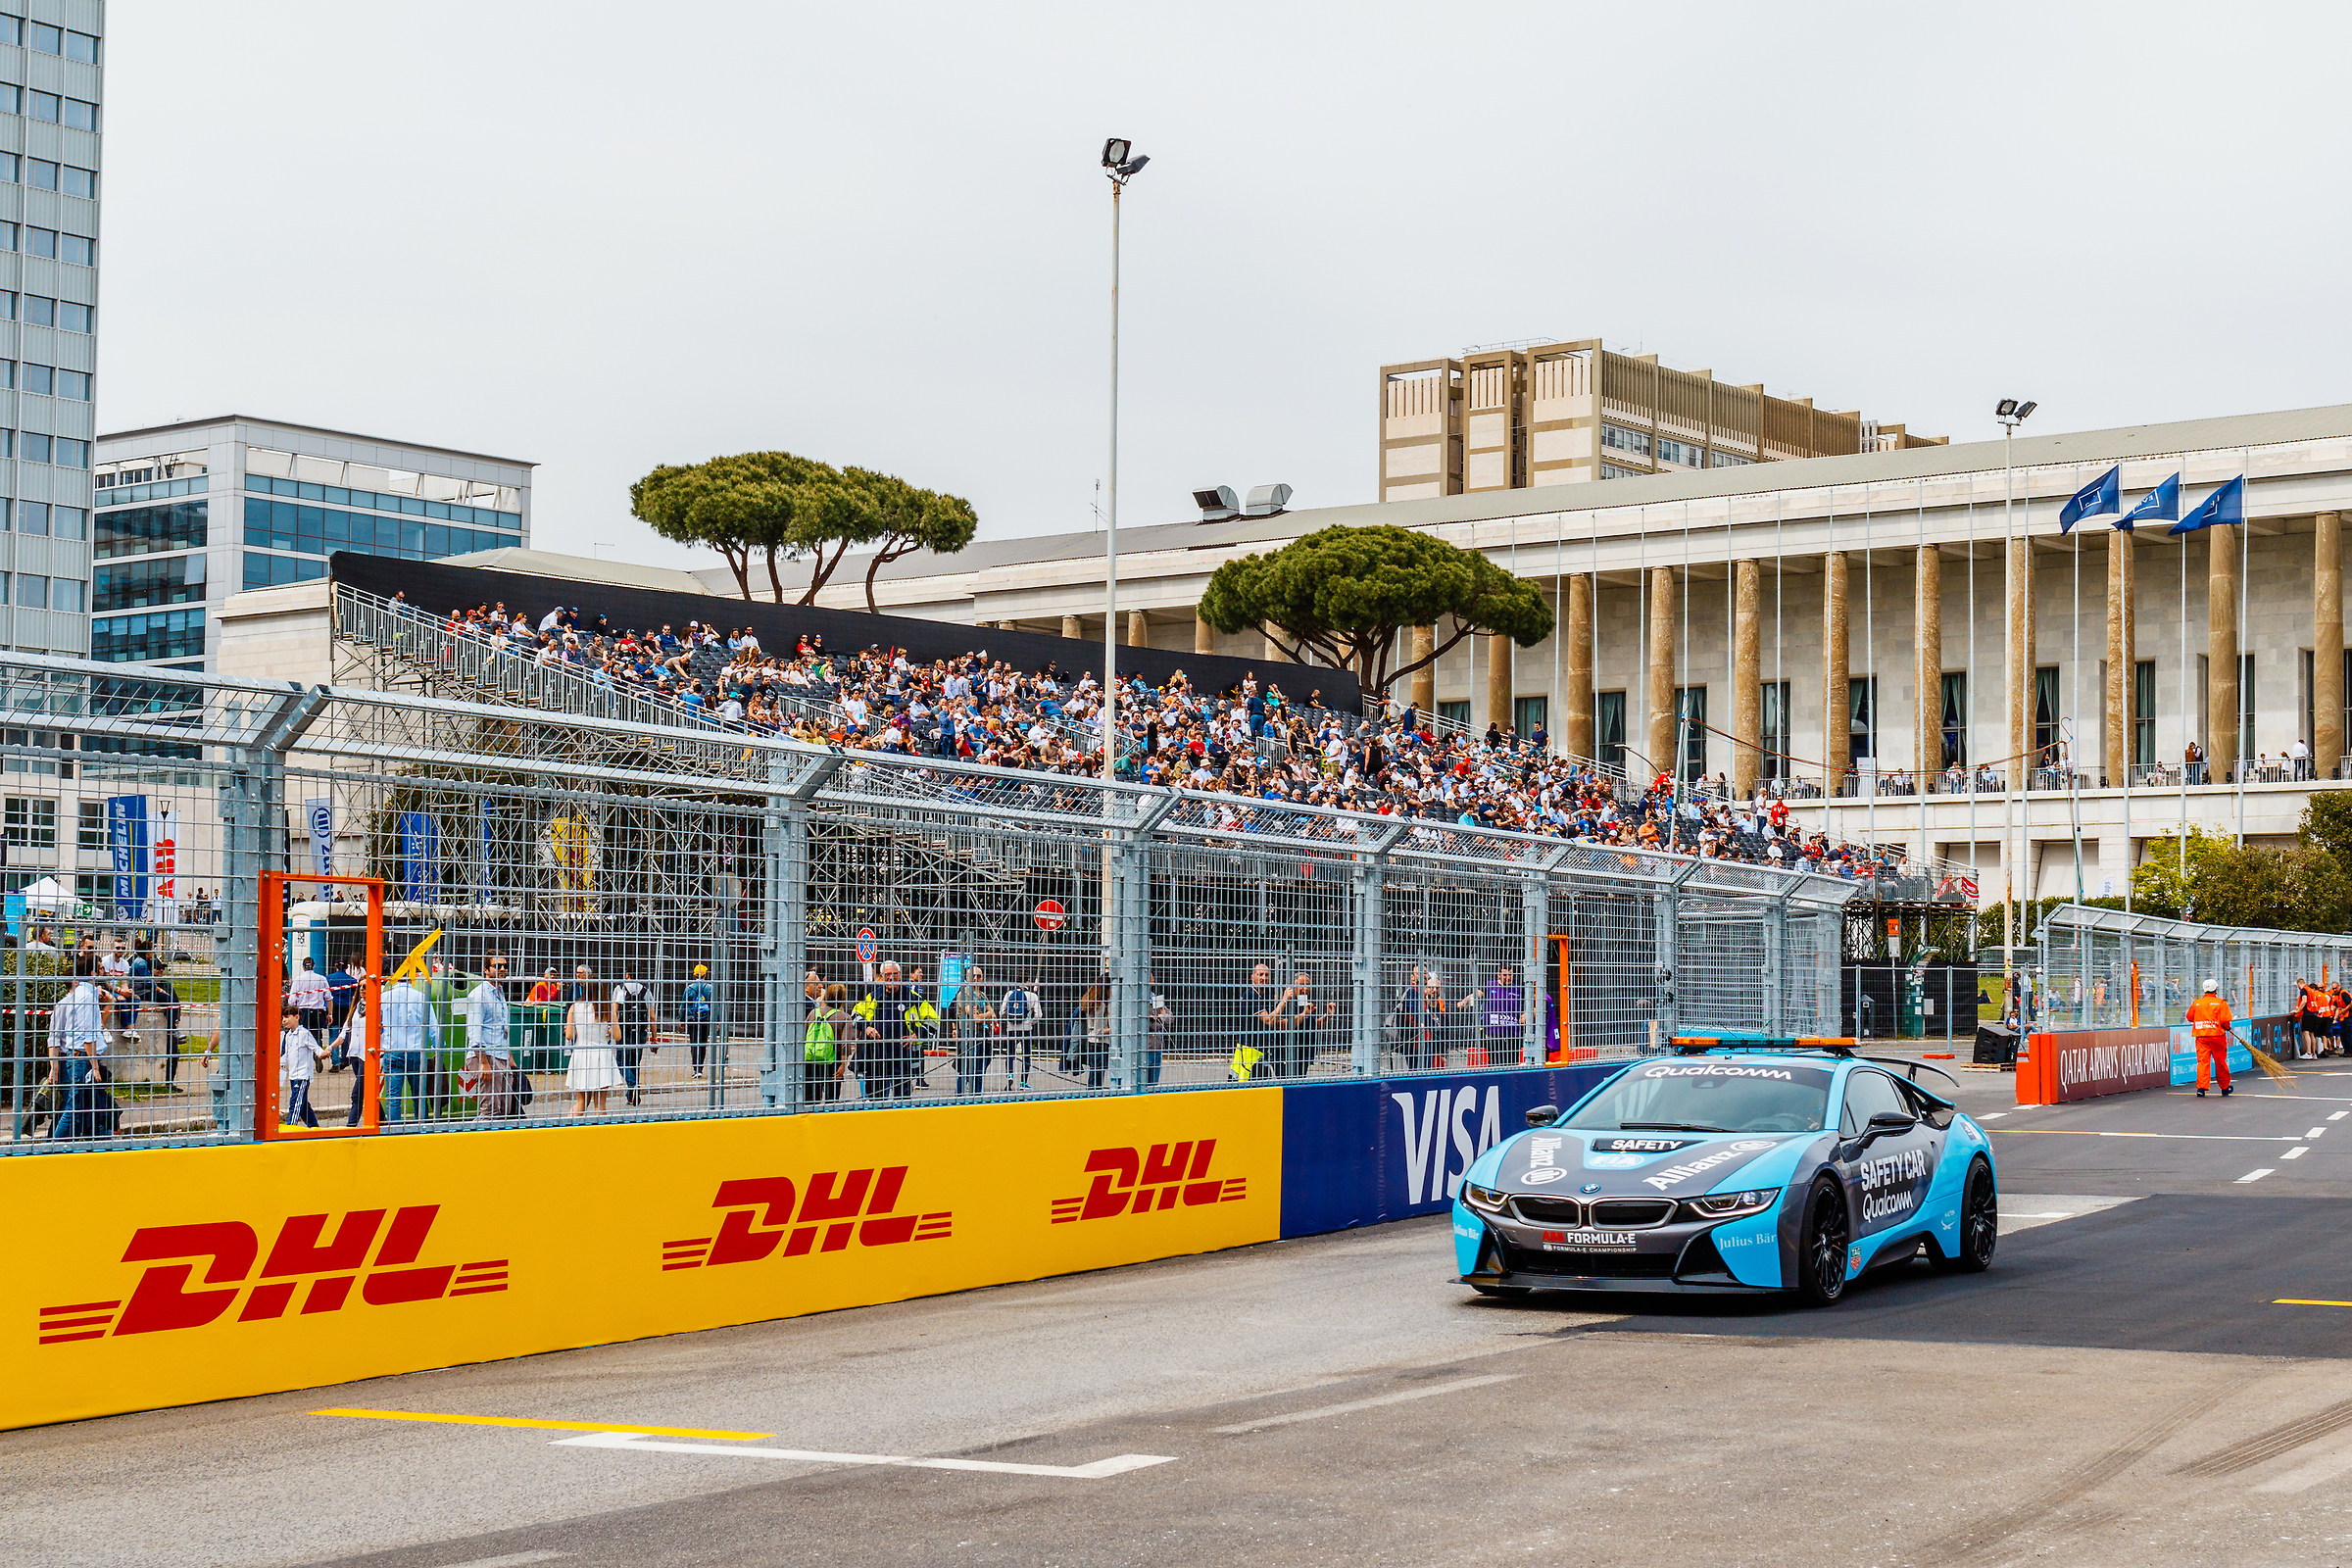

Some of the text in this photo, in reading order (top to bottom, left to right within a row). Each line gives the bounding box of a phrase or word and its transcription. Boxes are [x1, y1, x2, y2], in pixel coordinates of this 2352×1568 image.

[116, 803, 129, 898] MICHELIN
[1644, 1064, 1792, 1080] Qualcomm
[2060, 1049, 2087, 1094] QATAR
[2088, 1046, 2119, 1082] AIRWAYS
[2121, 1044, 2143, 1085] QATAR
[2143, 1041, 2169, 1074] AIRWAYS
[1392, 1085, 1502, 1205] VISA
[1530, 1136, 1563, 1169] Allianz
[1610, 1139, 1685, 1151] SAFETY
[1080, 1139, 1224, 1220] DHL
[1642, 1149, 1745, 1192] Allianz
[1860, 1149, 1927, 1192] SAFETY CAR
[706, 1165, 919, 1266] DHL
[1862, 1189, 1914, 1223] Qualcomm
[1543, 1230, 1565, 1243] ABB
[1719, 1233, 1777, 1250] Julius Bär
[112, 1204, 457, 1337] DHL
